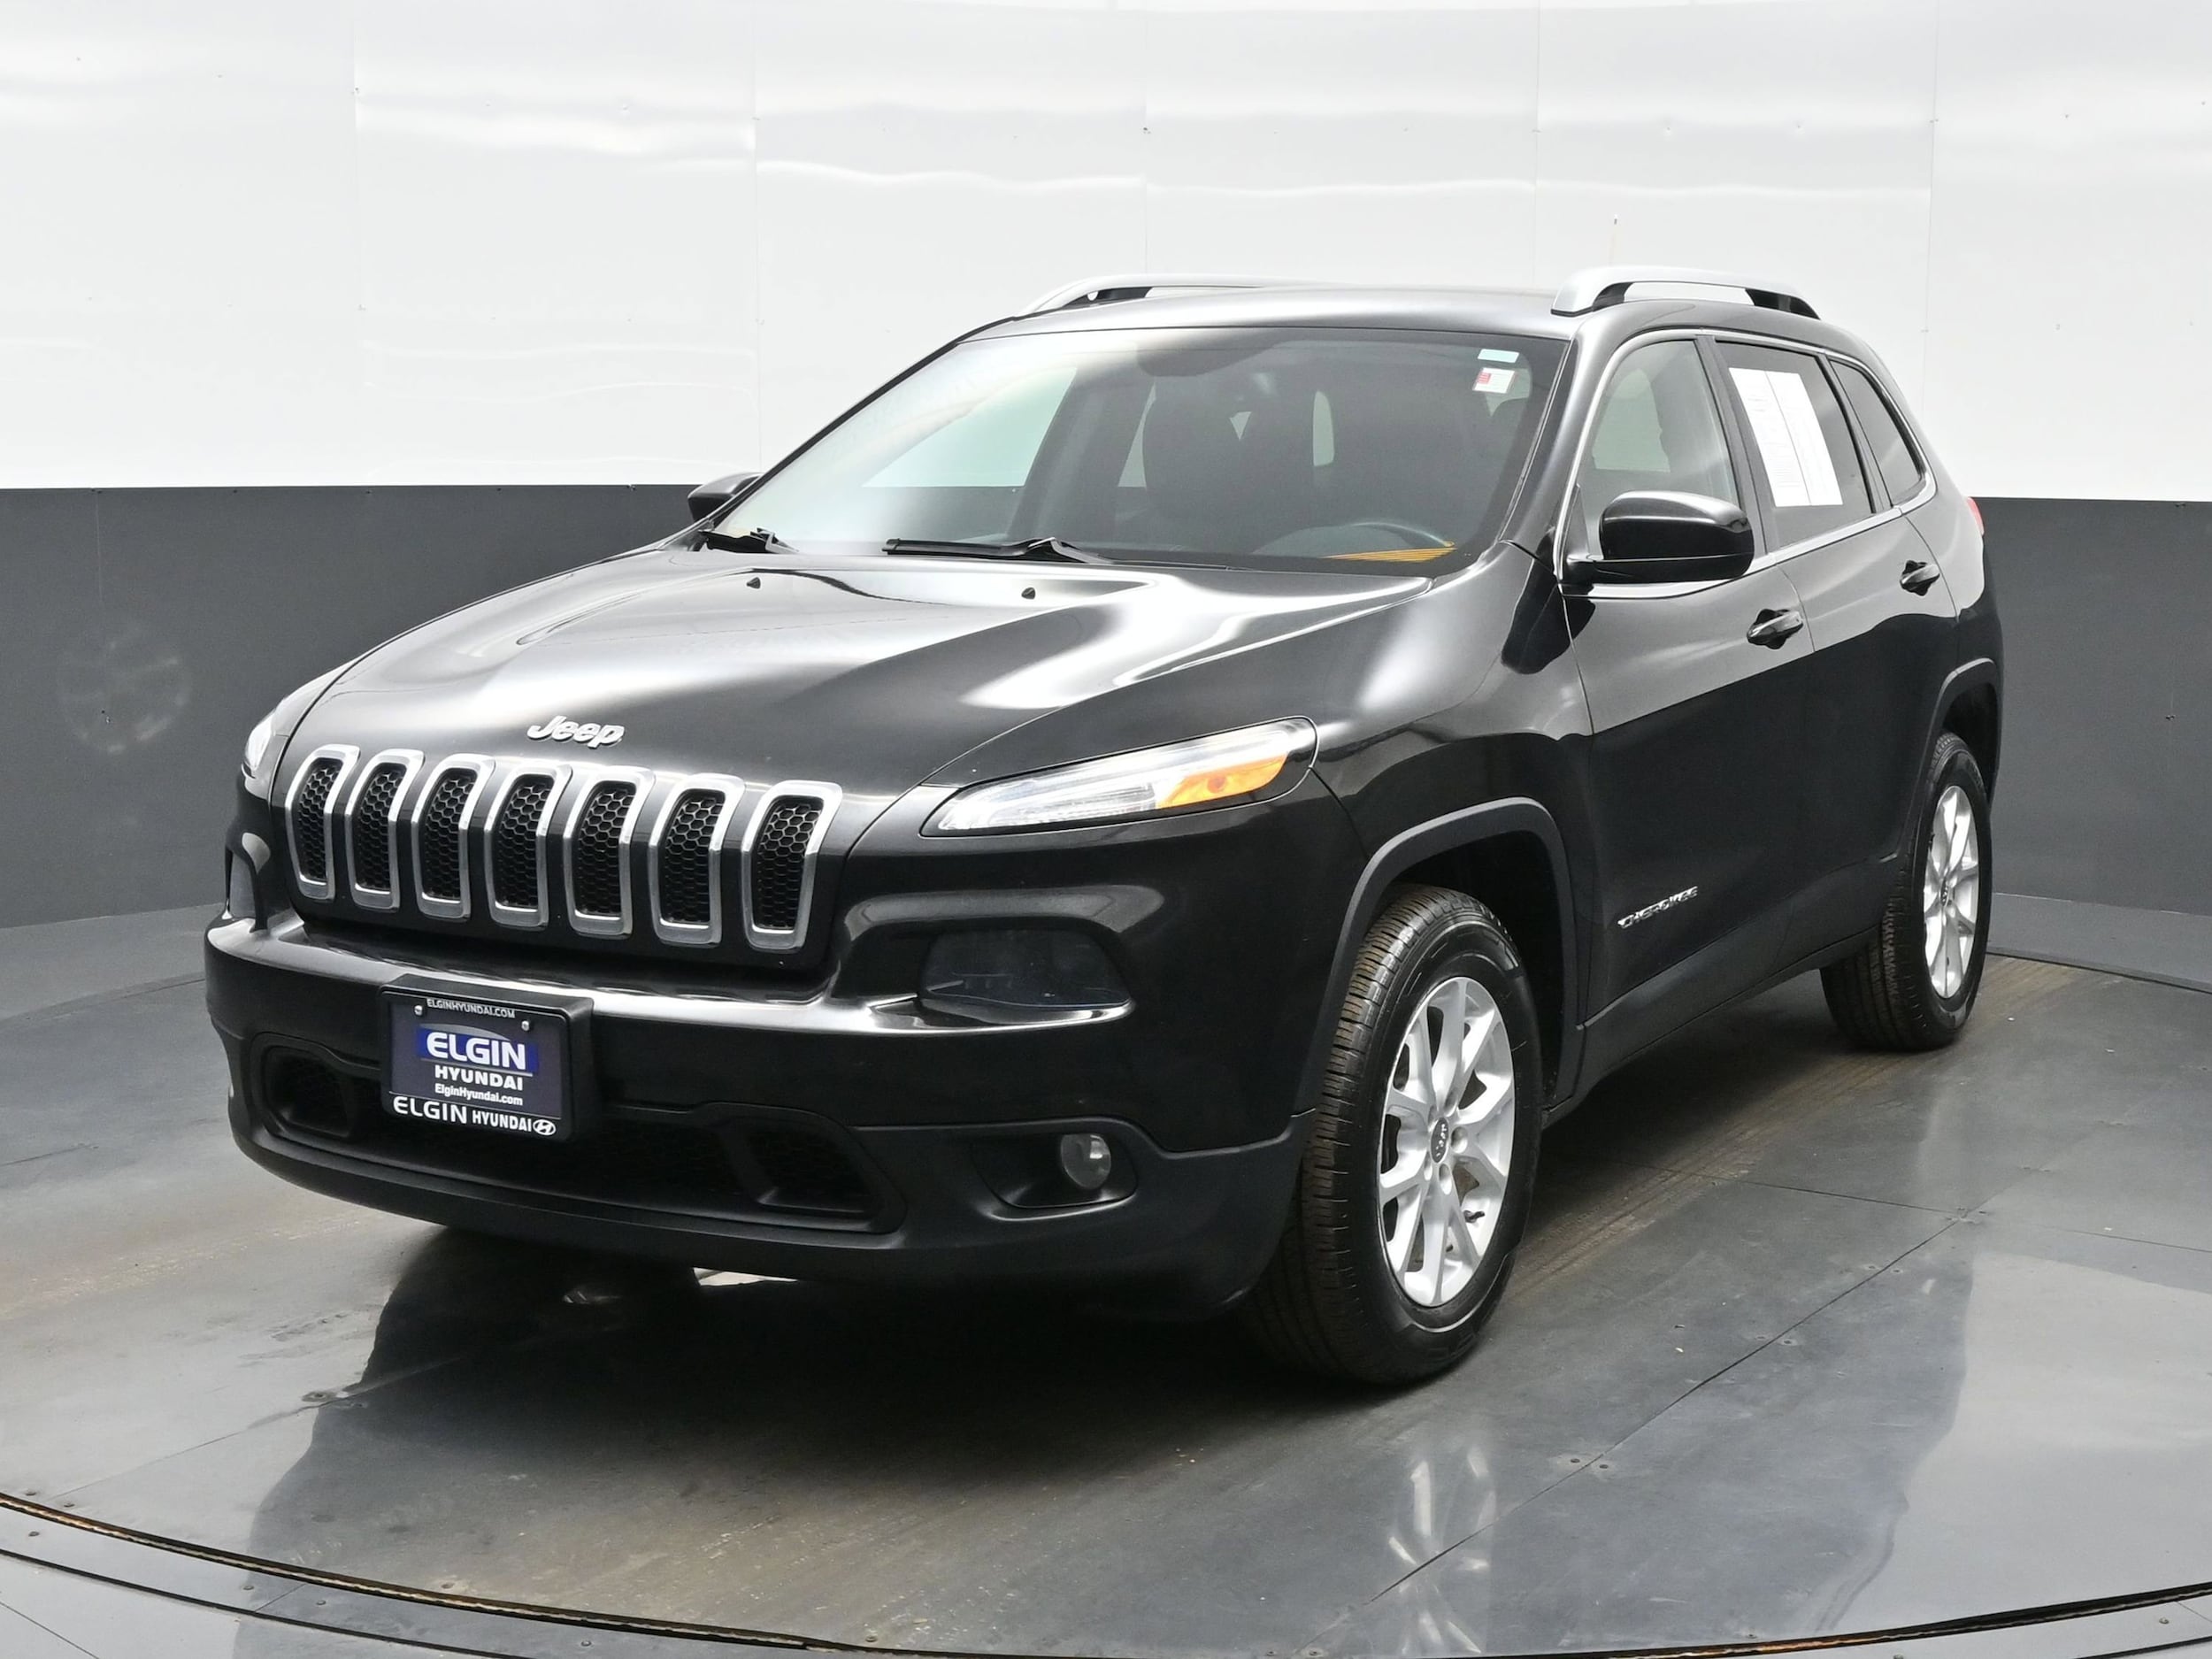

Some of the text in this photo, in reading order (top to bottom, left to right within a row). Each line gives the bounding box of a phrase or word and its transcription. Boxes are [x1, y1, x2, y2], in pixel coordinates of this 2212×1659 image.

[526, 715, 625, 749] Jeep
[426, 998, 516, 1018] ELGINHYUNDAI.COM
[426, 1032, 526, 1071] ELGIN
[434, 1065, 523, 1090] HYUNDAI
[434, 1083, 523, 1106] ElginHyundai.com
[393, 1096, 532, 1133] ELGIN HYUNDAI
